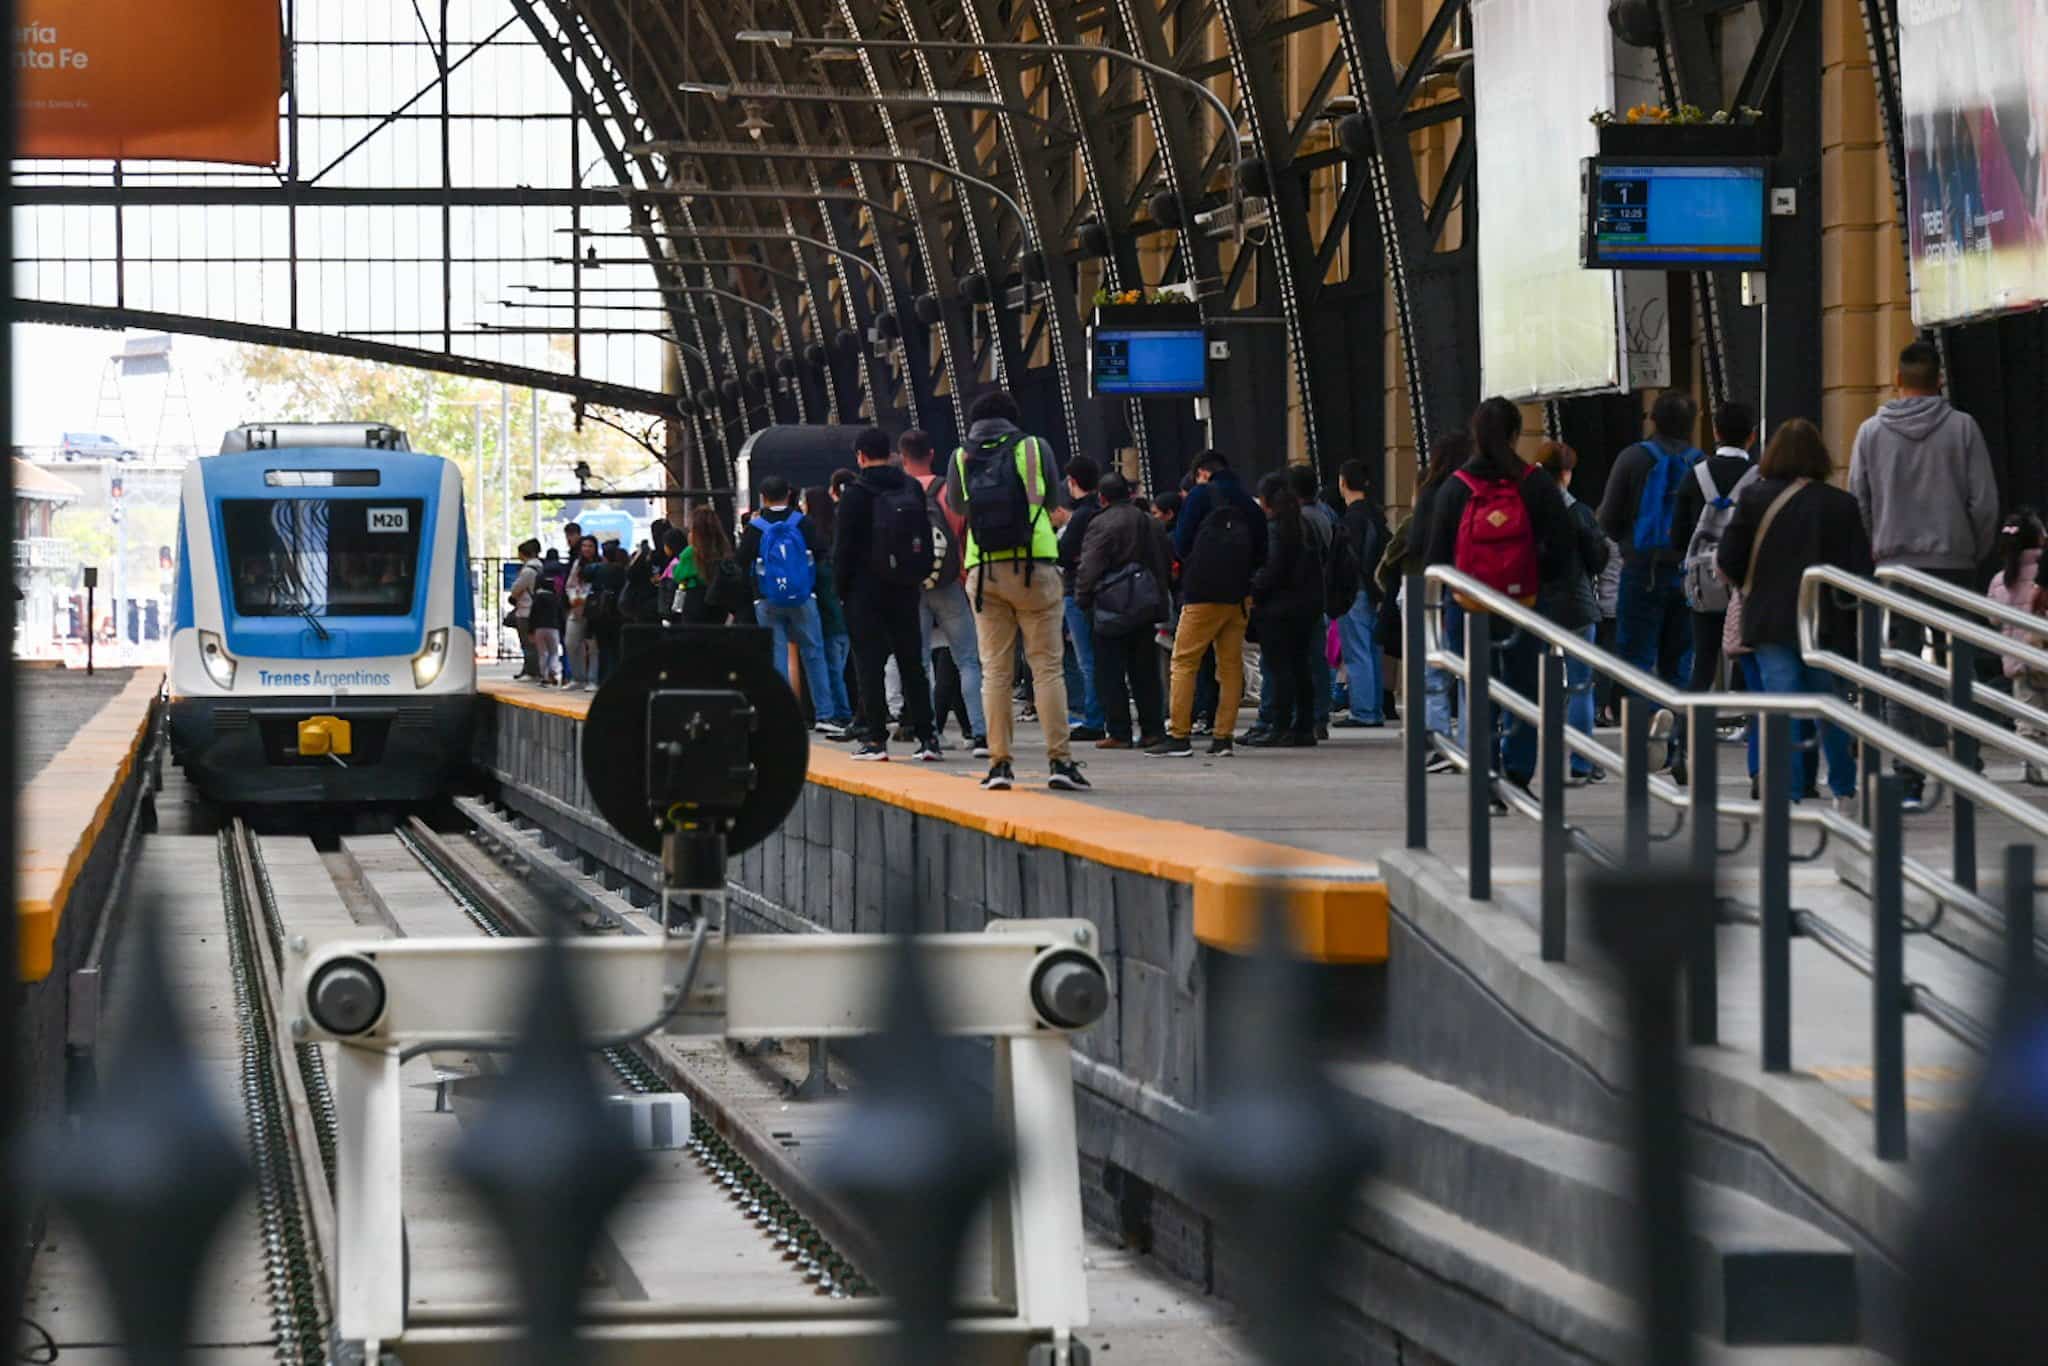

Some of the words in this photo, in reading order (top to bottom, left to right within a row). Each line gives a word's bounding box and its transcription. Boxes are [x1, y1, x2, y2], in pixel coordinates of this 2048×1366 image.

[59, 48, 88, 69] Fe
[1619, 188, 1628, 204] 1
[372, 514, 403, 528] M20
[258, 670, 311, 686] Trenes
[313, 669, 391, 687] Argentinos
